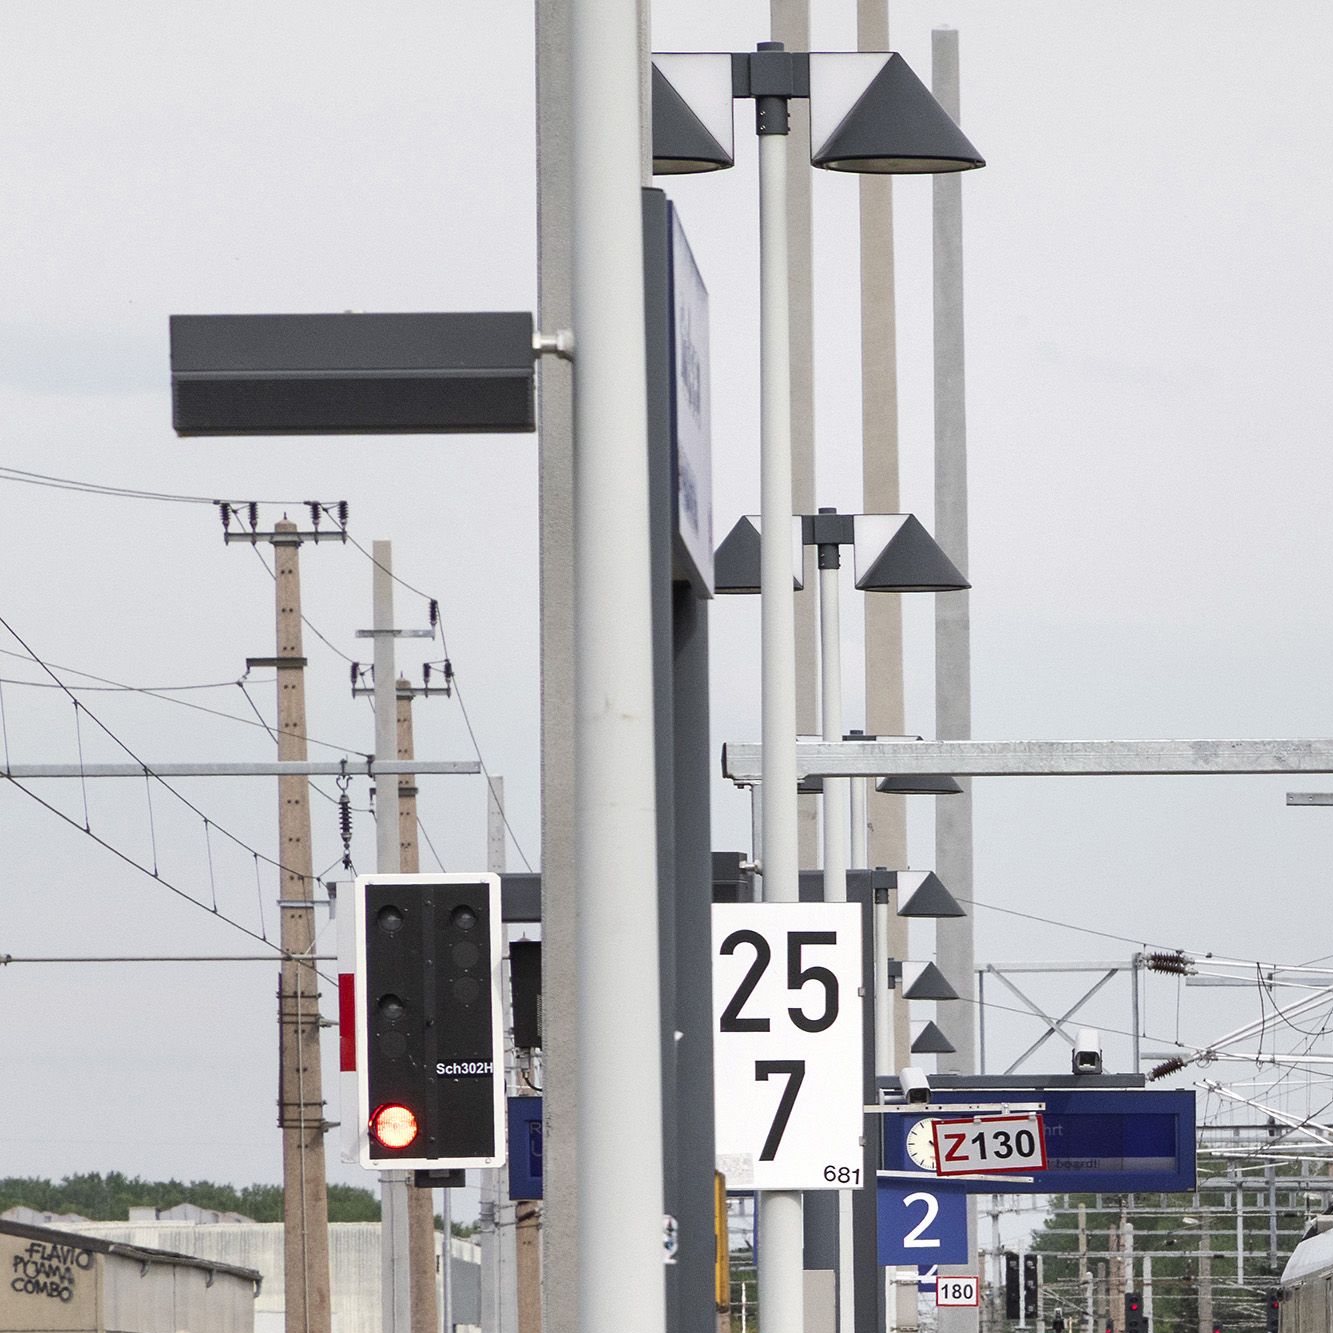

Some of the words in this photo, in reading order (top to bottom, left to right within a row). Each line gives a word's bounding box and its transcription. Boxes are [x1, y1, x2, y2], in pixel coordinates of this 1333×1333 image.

[719, 930, 839, 1034] 25
[436, 1061, 493, 1076] Sch302H
[754, 1059, 806, 1162] 7
[944, 1129, 1036, 1163] Z130
[823, 1165, 860, 1185] 681
[902, 1191, 941, 1249] 2
[25, 1242, 94, 1271] FLAVIO
[10, 1277, 73, 1304] COMBO
[941, 1283, 974, 1301] 180
